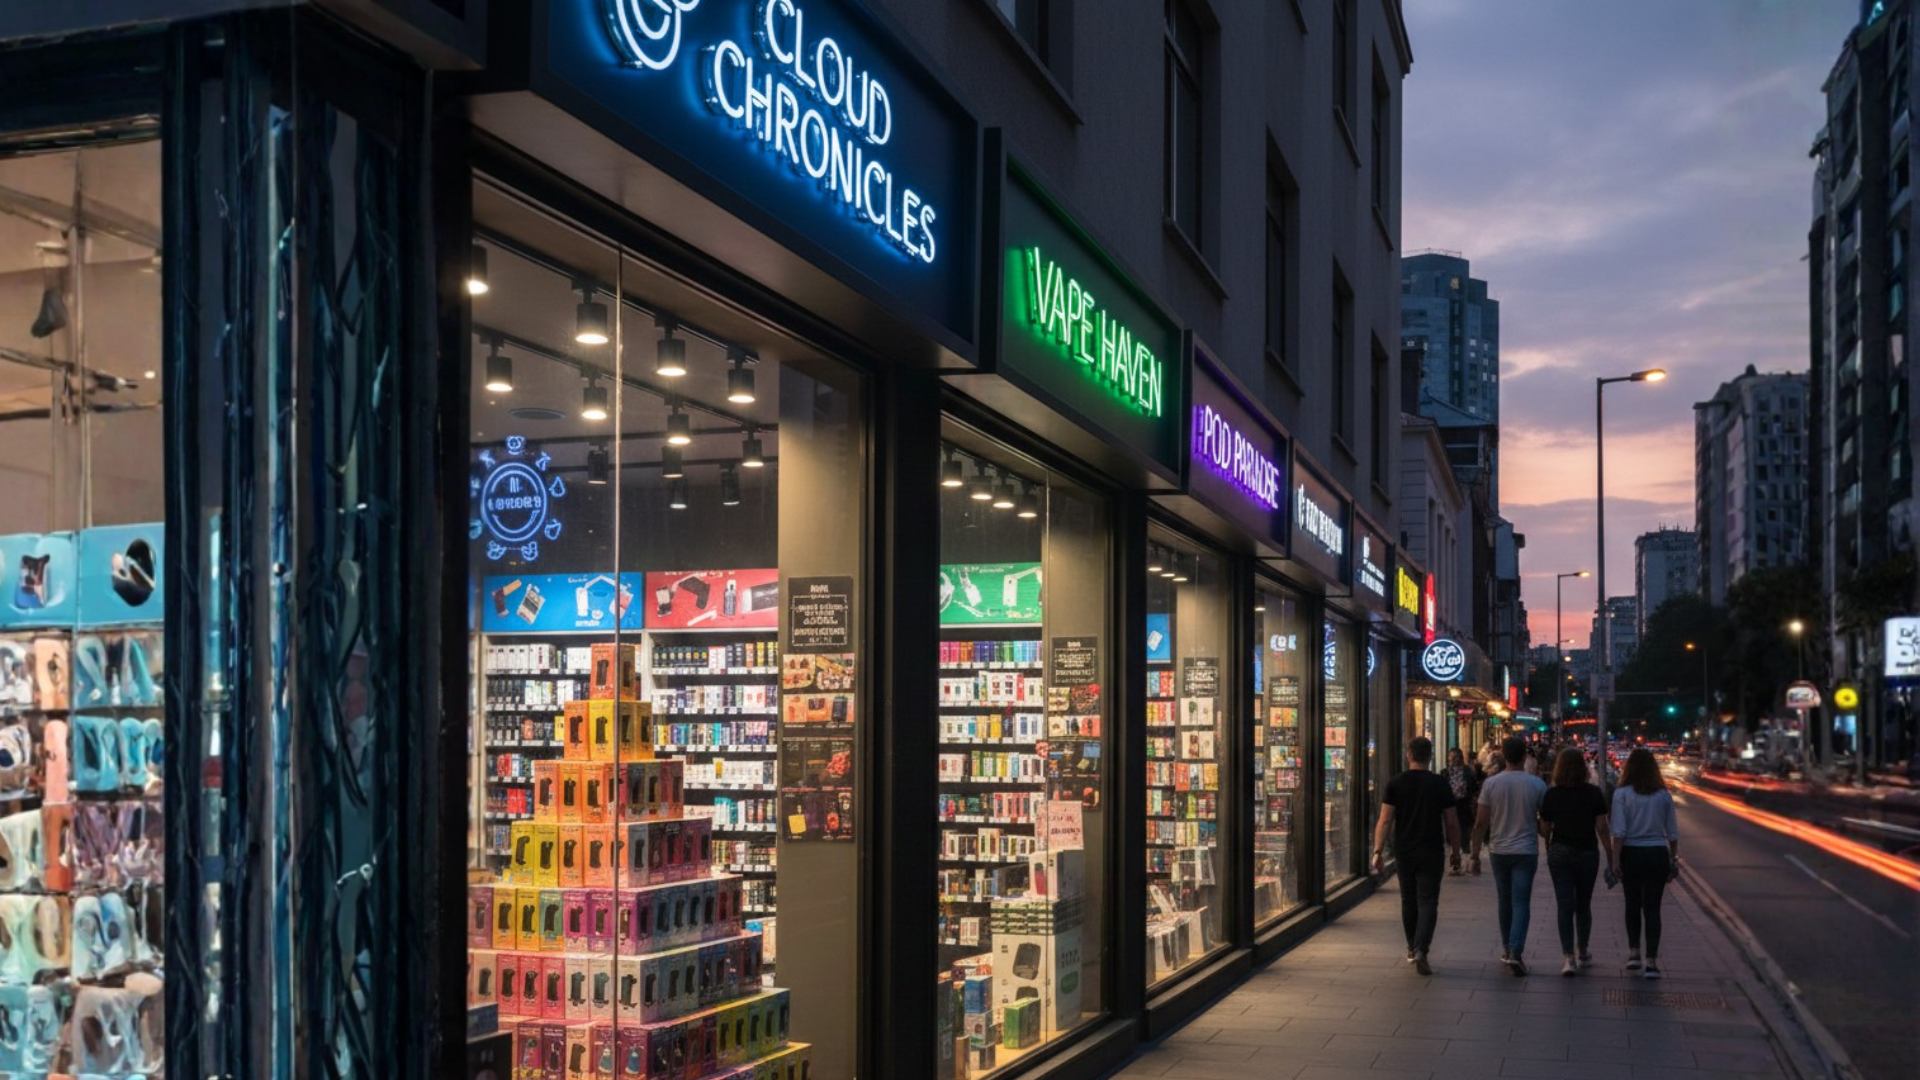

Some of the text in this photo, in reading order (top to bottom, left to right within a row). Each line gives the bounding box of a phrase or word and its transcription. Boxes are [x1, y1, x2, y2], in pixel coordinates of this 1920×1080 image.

[714, 40, 936, 263] CHRONICLES
[766, 0, 891, 145] CLOUD
[1034, 247, 1162, 418] VAPE HAVEN
[1203, 405, 1232, 469] POD
